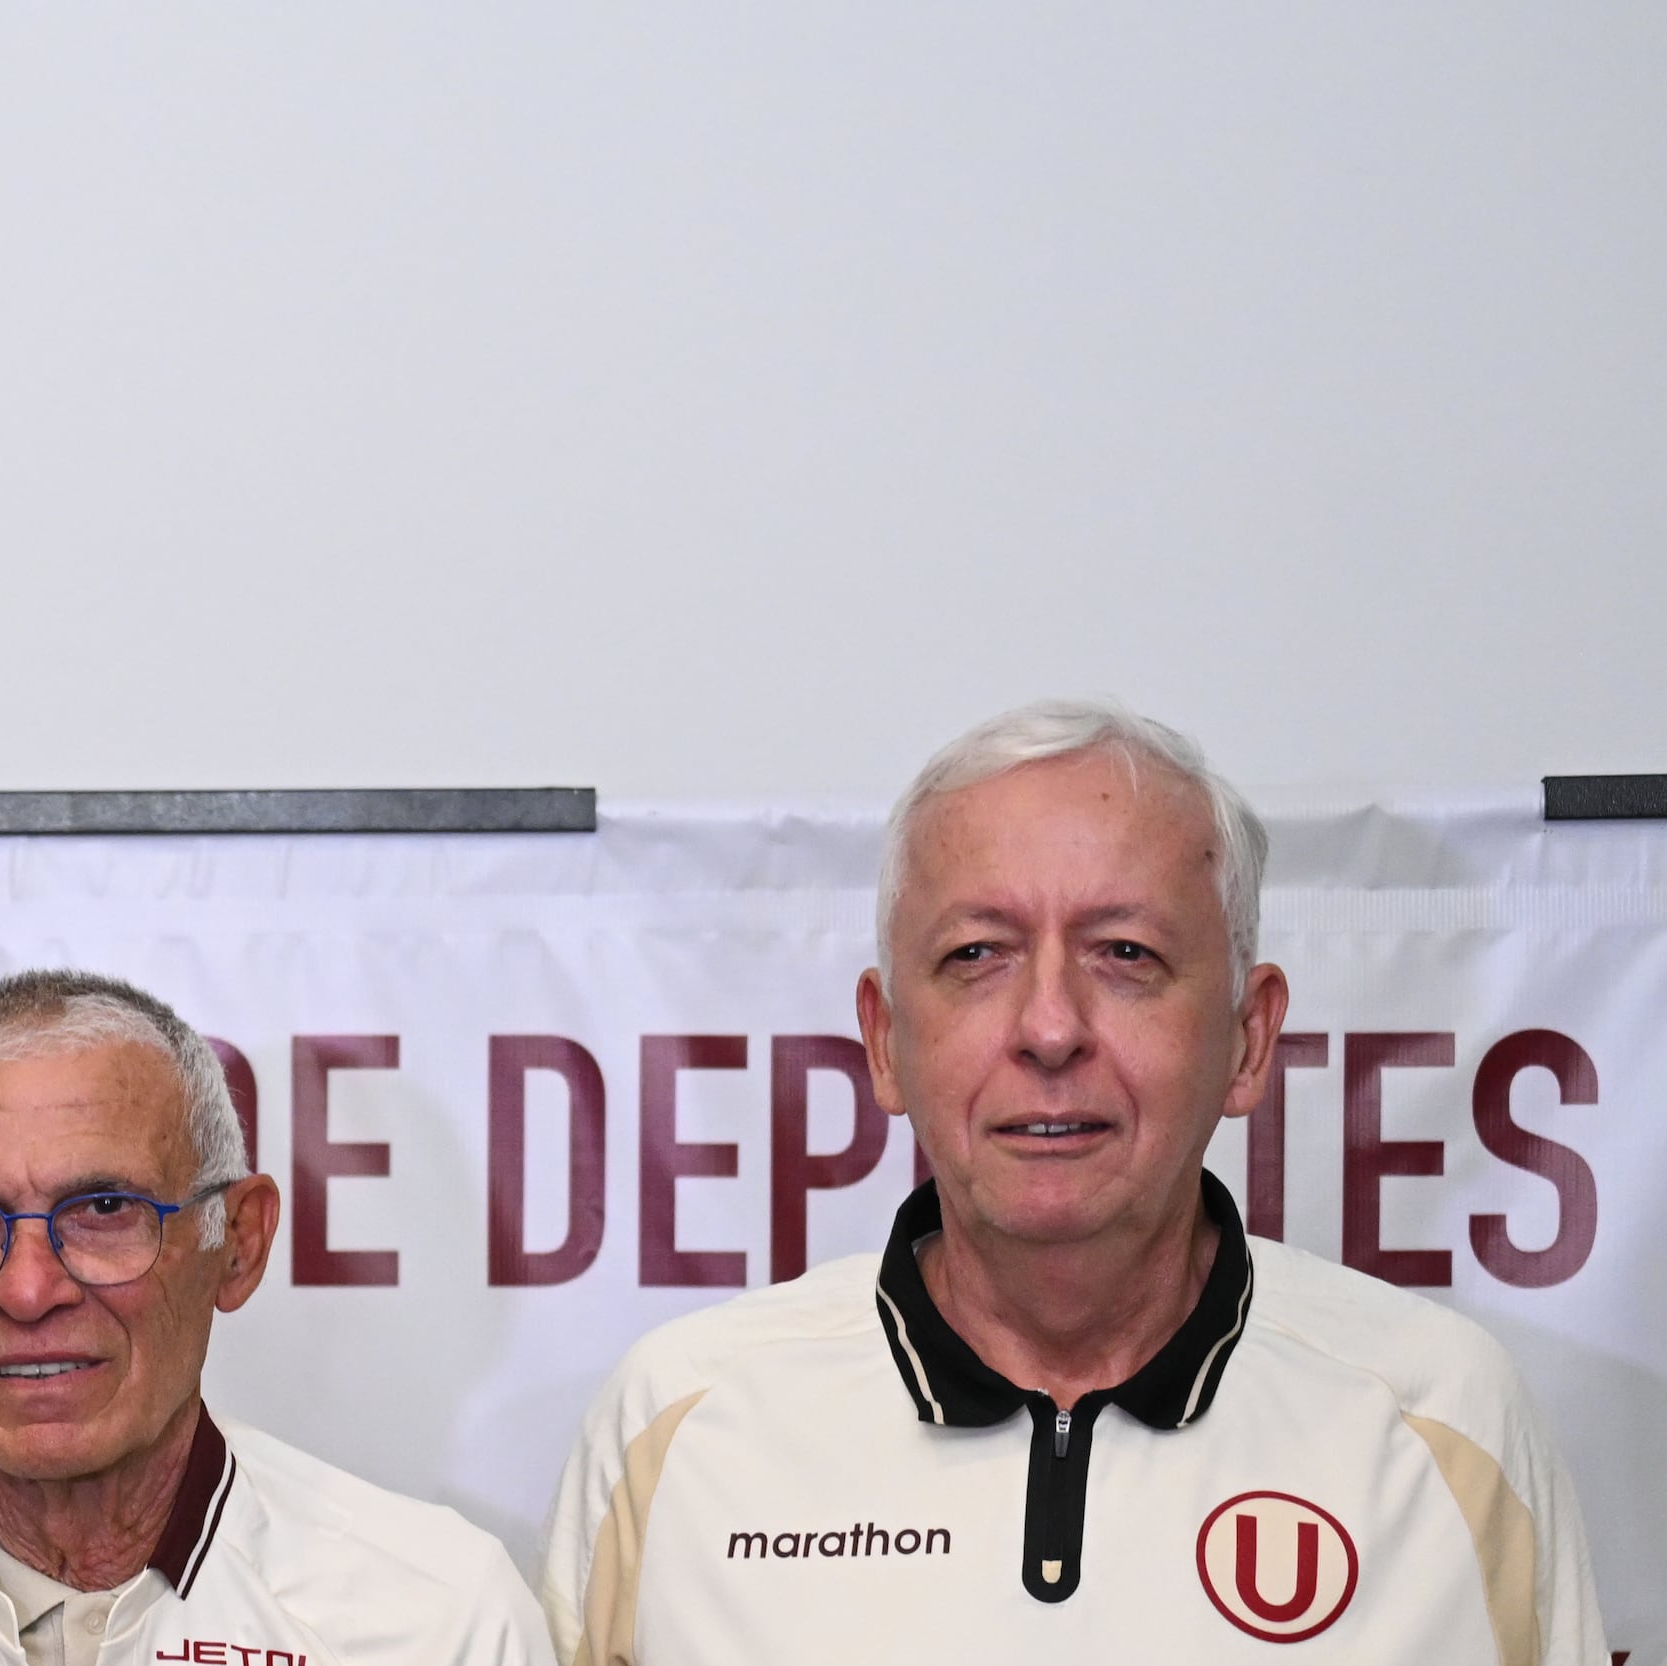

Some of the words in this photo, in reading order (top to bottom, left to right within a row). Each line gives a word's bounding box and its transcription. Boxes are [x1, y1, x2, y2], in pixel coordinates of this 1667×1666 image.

[487, 1029, 1600, 1290] DEPTES
[726, 1521, 952, 1560] marathon
[1235, 1513, 1319, 1624] U
